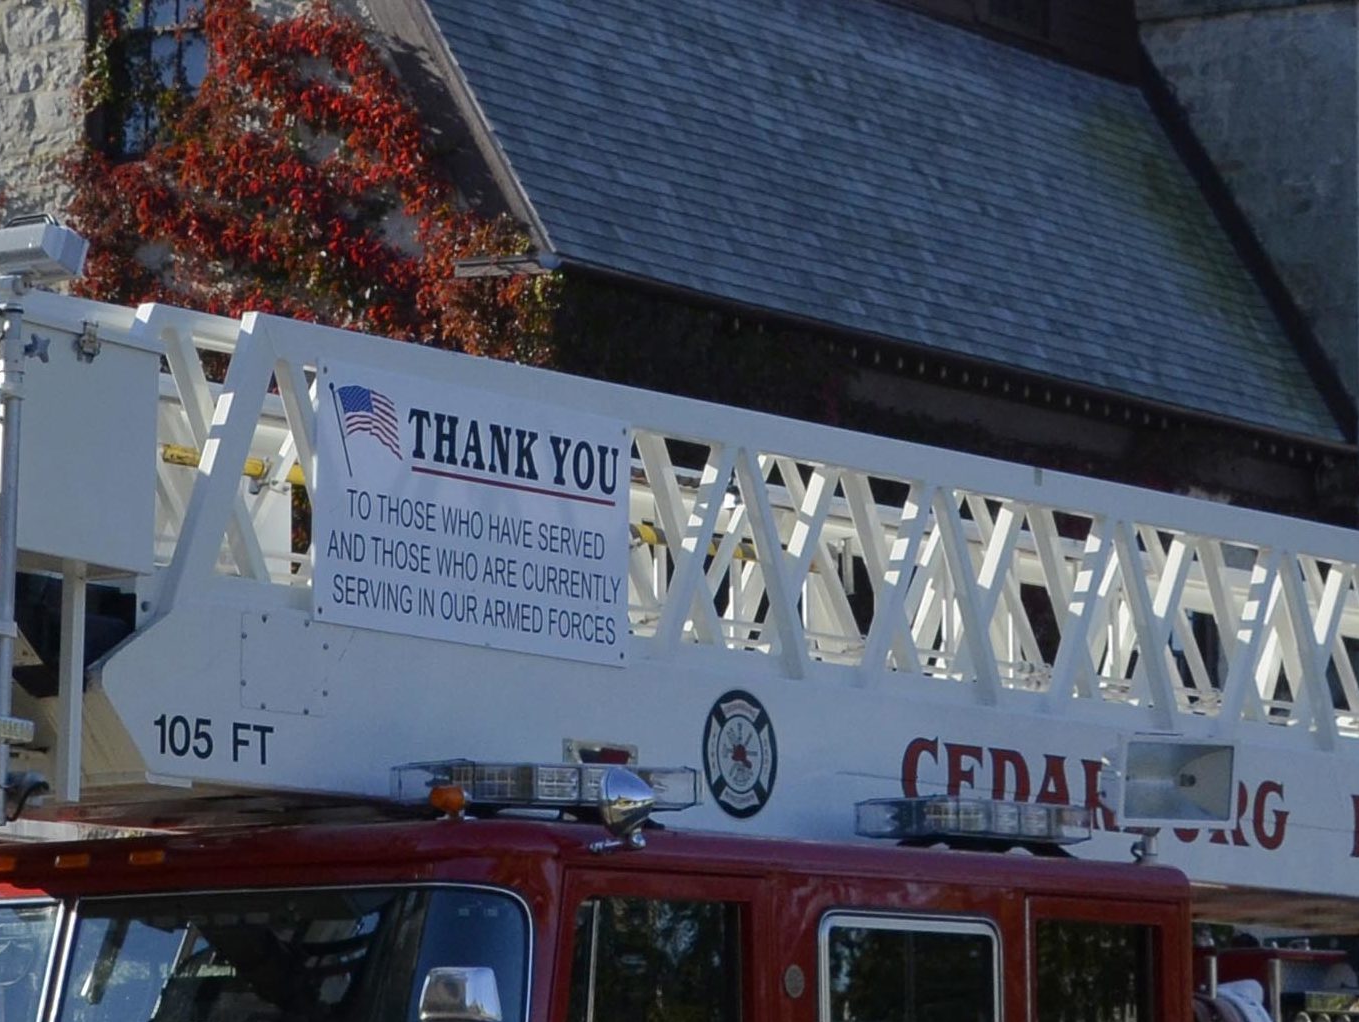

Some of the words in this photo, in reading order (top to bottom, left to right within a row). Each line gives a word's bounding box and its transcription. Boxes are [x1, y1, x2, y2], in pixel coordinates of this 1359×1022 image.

[408, 408, 539, 481] THANK
[549, 435, 619, 495] YOU
[346, 488, 372, 520] TO
[377, 494, 436, 532] THOSE
[442, 505, 484, 540] WHO
[488, 514, 533, 549] HAVE
[537, 522, 605, 560] SERVED
[327, 530, 366, 563] AND
[371, 536, 431, 574] THOSE
[437, 547, 478, 582] WHO
[482, 556, 517, 588] ARE
[522, 562, 622, 604] CURRENTLY
[332, 573, 413, 614] SERVING
[418, 587, 435, 618] IN
[440, 591, 478, 625] OUR
[482, 599, 543, 634] ARMED
[548, 608, 617, 645] FORCES
[153, 713, 214, 760] 105
[232, 722, 275, 765] FT
[901, 735, 1291, 851] CEDARRG
